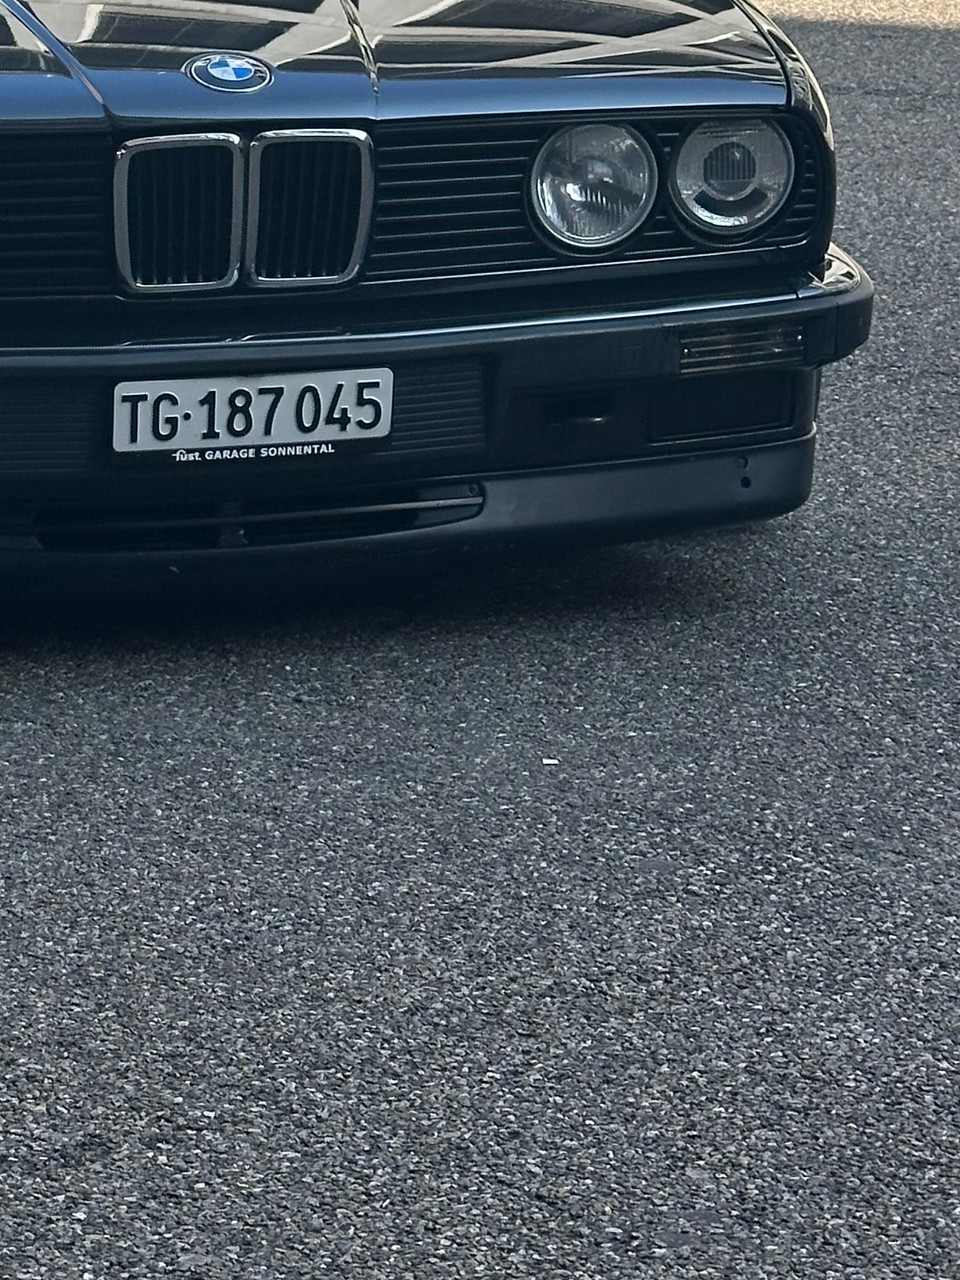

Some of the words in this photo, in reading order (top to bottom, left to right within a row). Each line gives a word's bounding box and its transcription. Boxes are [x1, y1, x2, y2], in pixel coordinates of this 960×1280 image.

[295, 380, 382, 434] 045
[204, 448, 256, 460] GARAGE
[260, 444, 335, 457] SONNENTAL
